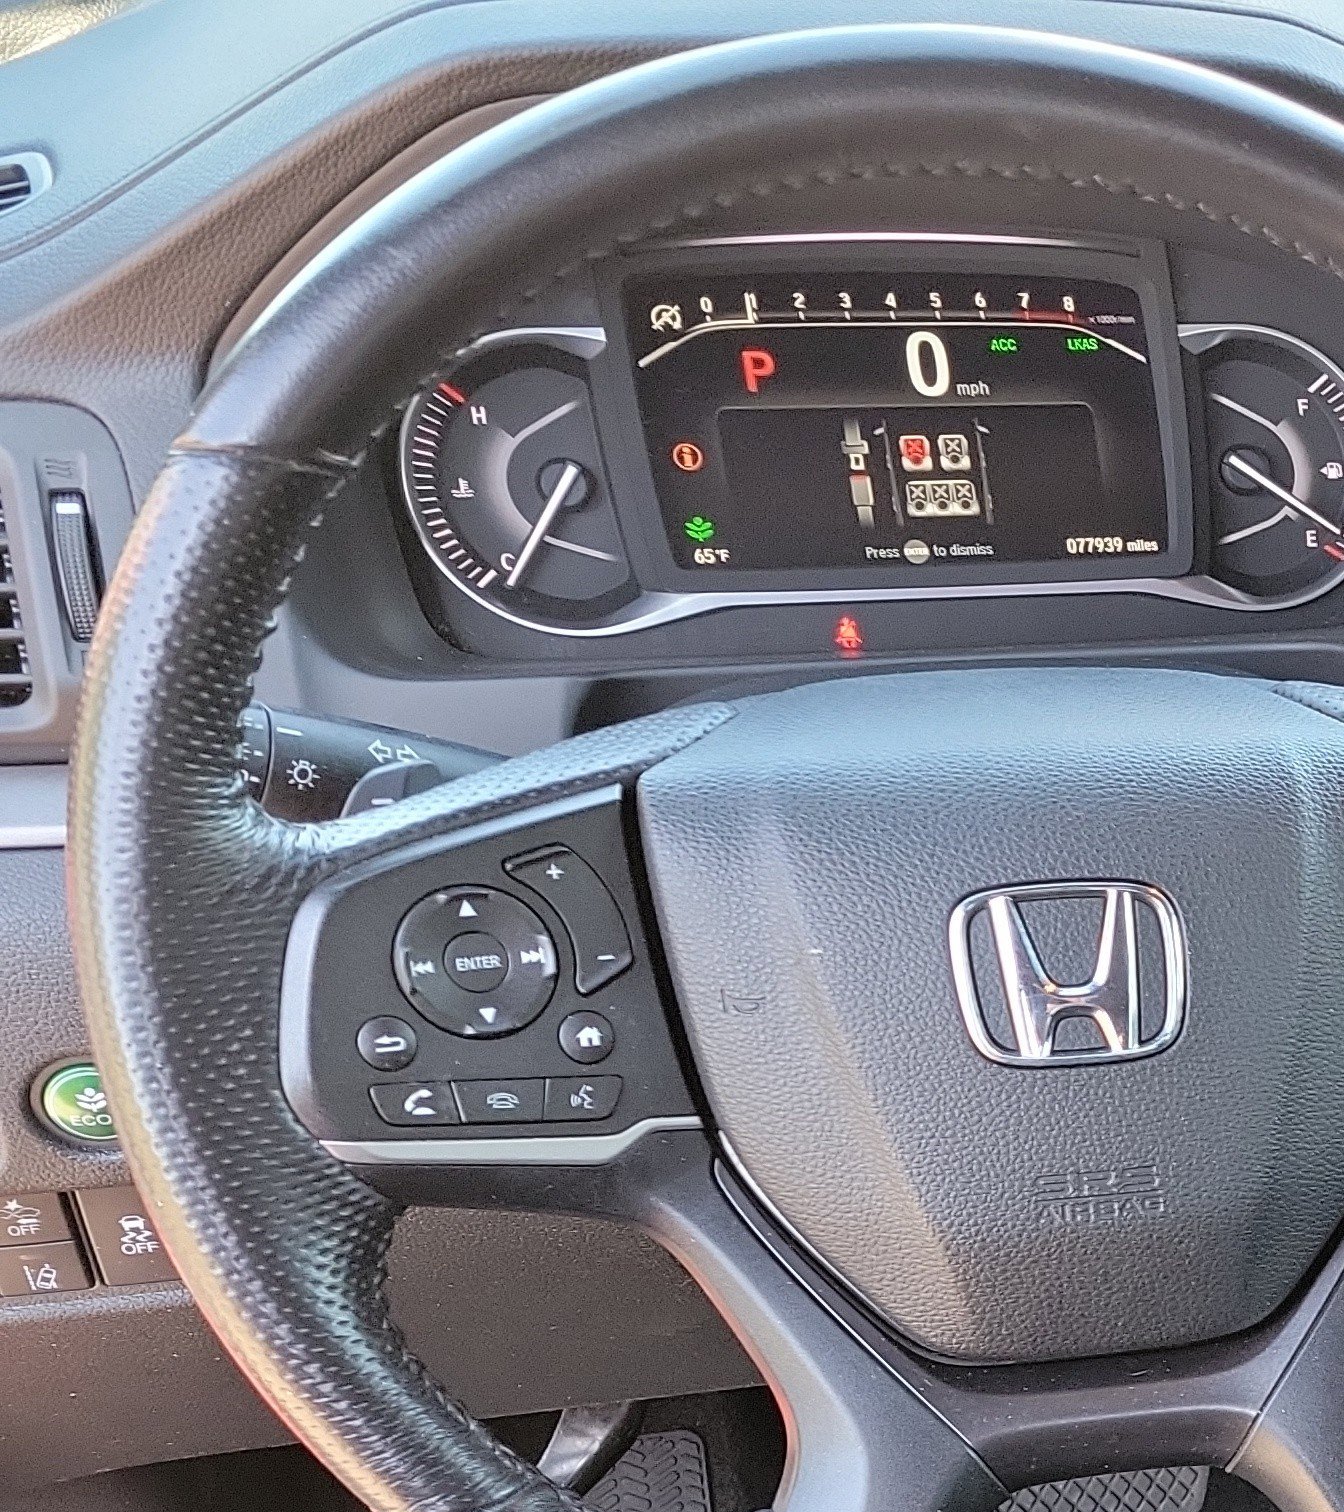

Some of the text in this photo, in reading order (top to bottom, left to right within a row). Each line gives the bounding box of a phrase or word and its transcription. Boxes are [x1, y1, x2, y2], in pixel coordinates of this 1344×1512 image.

[700, 296, 713, 313] 0
[793, 292, 806, 308] 2
[838, 292, 851, 308] 3
[885, 292, 897, 308] 4
[929, 292, 941, 308] 5
[975, 292, 986, 308] 6
[1016, 292, 1030, 309] 7
[1062, 296, 1075, 312] 8
[990, 338, 1018, 351] ACC
[1067, 338, 1099, 351] LKAS
[742, 349, 775, 392] P
[906, 331, 990, 397] 0 mph
[470, 406, 487, 425] H
[1297, 398, 1309, 416] F
[1066, 537, 1159, 554] 077939 miles
[1306, 530, 1318, 548] E
[694, 548, 731, 565] 65°F
[865, 546, 900, 559] Press
[933, 544, 947, 556] to
[949, 543, 994, 556] dismiss
[455, 955, 502, 972] ENTER
[70, 1114, 112, 1127] ECO
[8, 1224, 41, 1237] OFF
[121, 1243, 159, 1255] OFF
